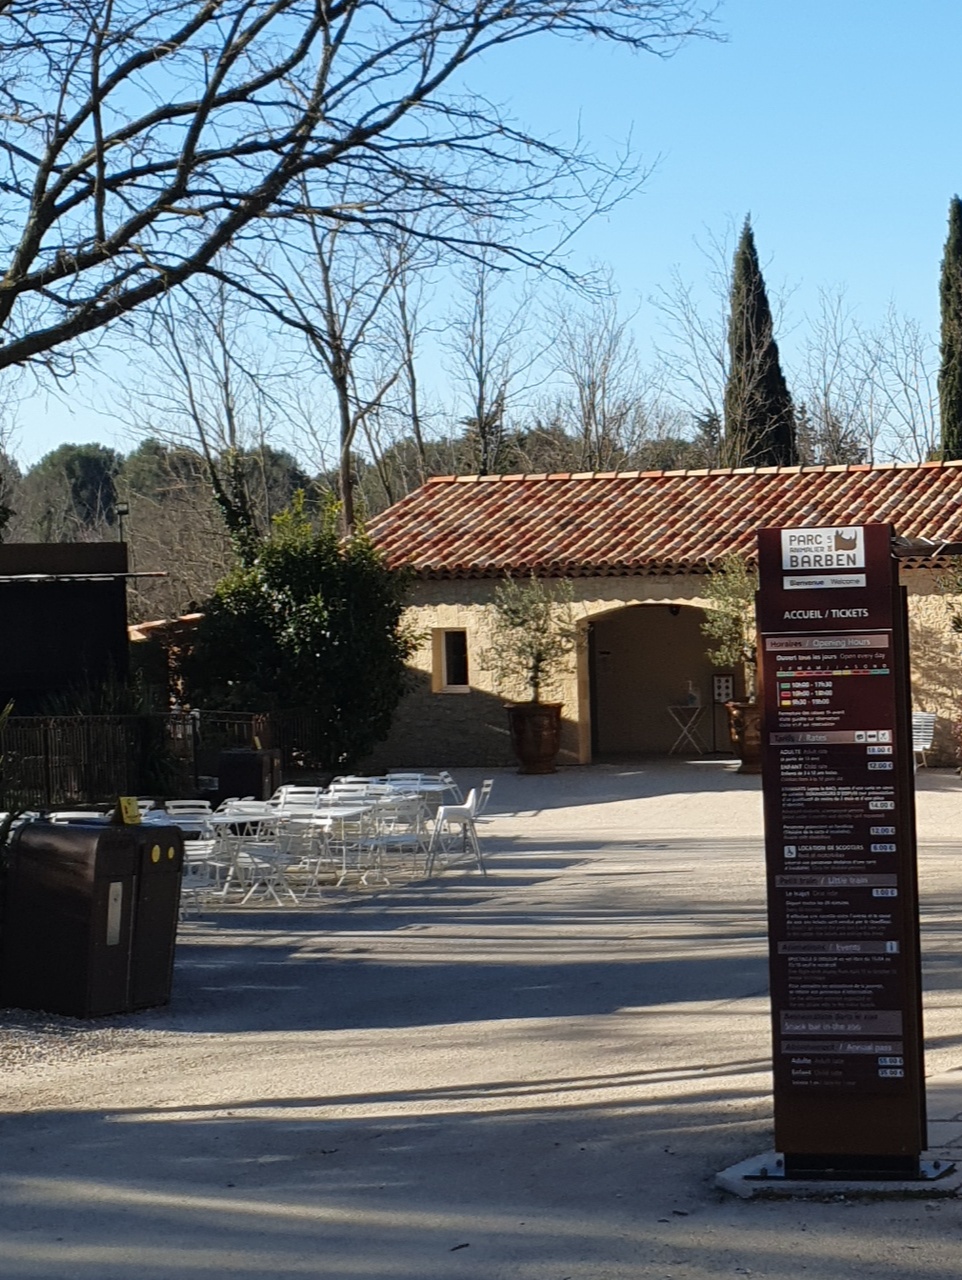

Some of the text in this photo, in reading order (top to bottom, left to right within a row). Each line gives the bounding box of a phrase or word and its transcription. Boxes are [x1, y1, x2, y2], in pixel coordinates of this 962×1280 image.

[789, 534, 822, 546] PARC
[790, 554, 857, 568] BARBEN
[783, 610, 822, 619] ACCUEIL
[831, 608, 869, 618] TICKETS
[812, 639, 846, 648] Opening
[847, 638, 871, 646] Hours
